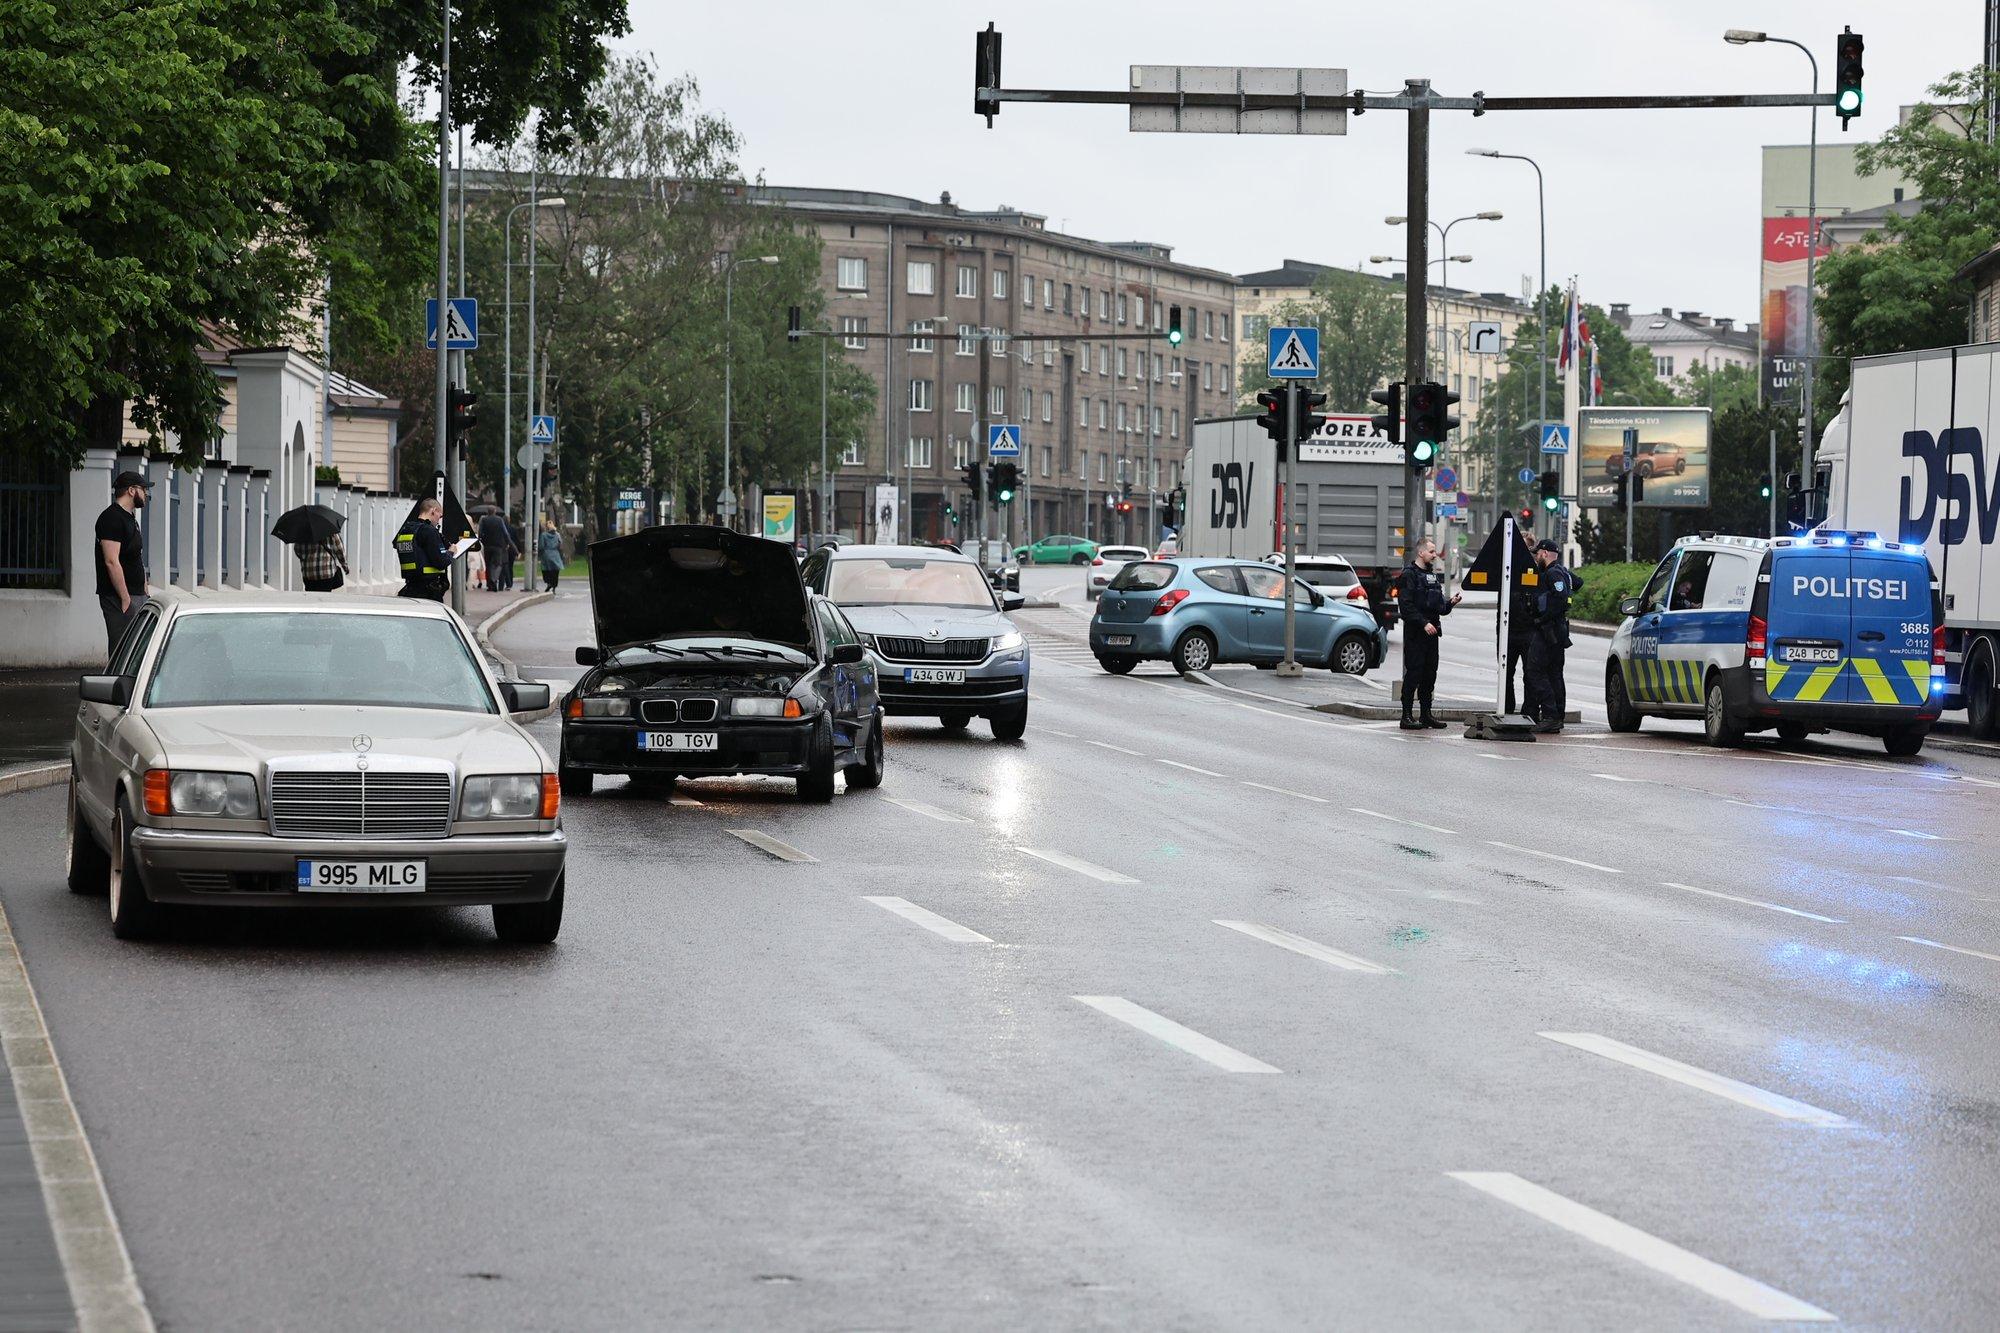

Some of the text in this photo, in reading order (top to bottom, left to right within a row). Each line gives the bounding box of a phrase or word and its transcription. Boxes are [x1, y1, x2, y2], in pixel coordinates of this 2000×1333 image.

[1774, 232, 1819, 247] ARTE
[1898, 427, 2000, 545] DSV
[620, 491, 642, 500] KERGE
[1211, 461, 1254, 529] DSV
[1793, 576, 1907, 600] POLITSEI
[1900, 623, 1930, 635] 3685
[1631, 636, 1658, 655] POLITSEI
[1914, 639, 1929, 648] 112
[1788, 648, 1807, 659] 248
[1813, 649, 1835, 660] PCC
[914, 670, 933, 681] 434
[936, 670, 963, 681] GWJ
[650, 734, 714, 748] 108 TGV
[319, 864, 418, 886] 995 MLG
